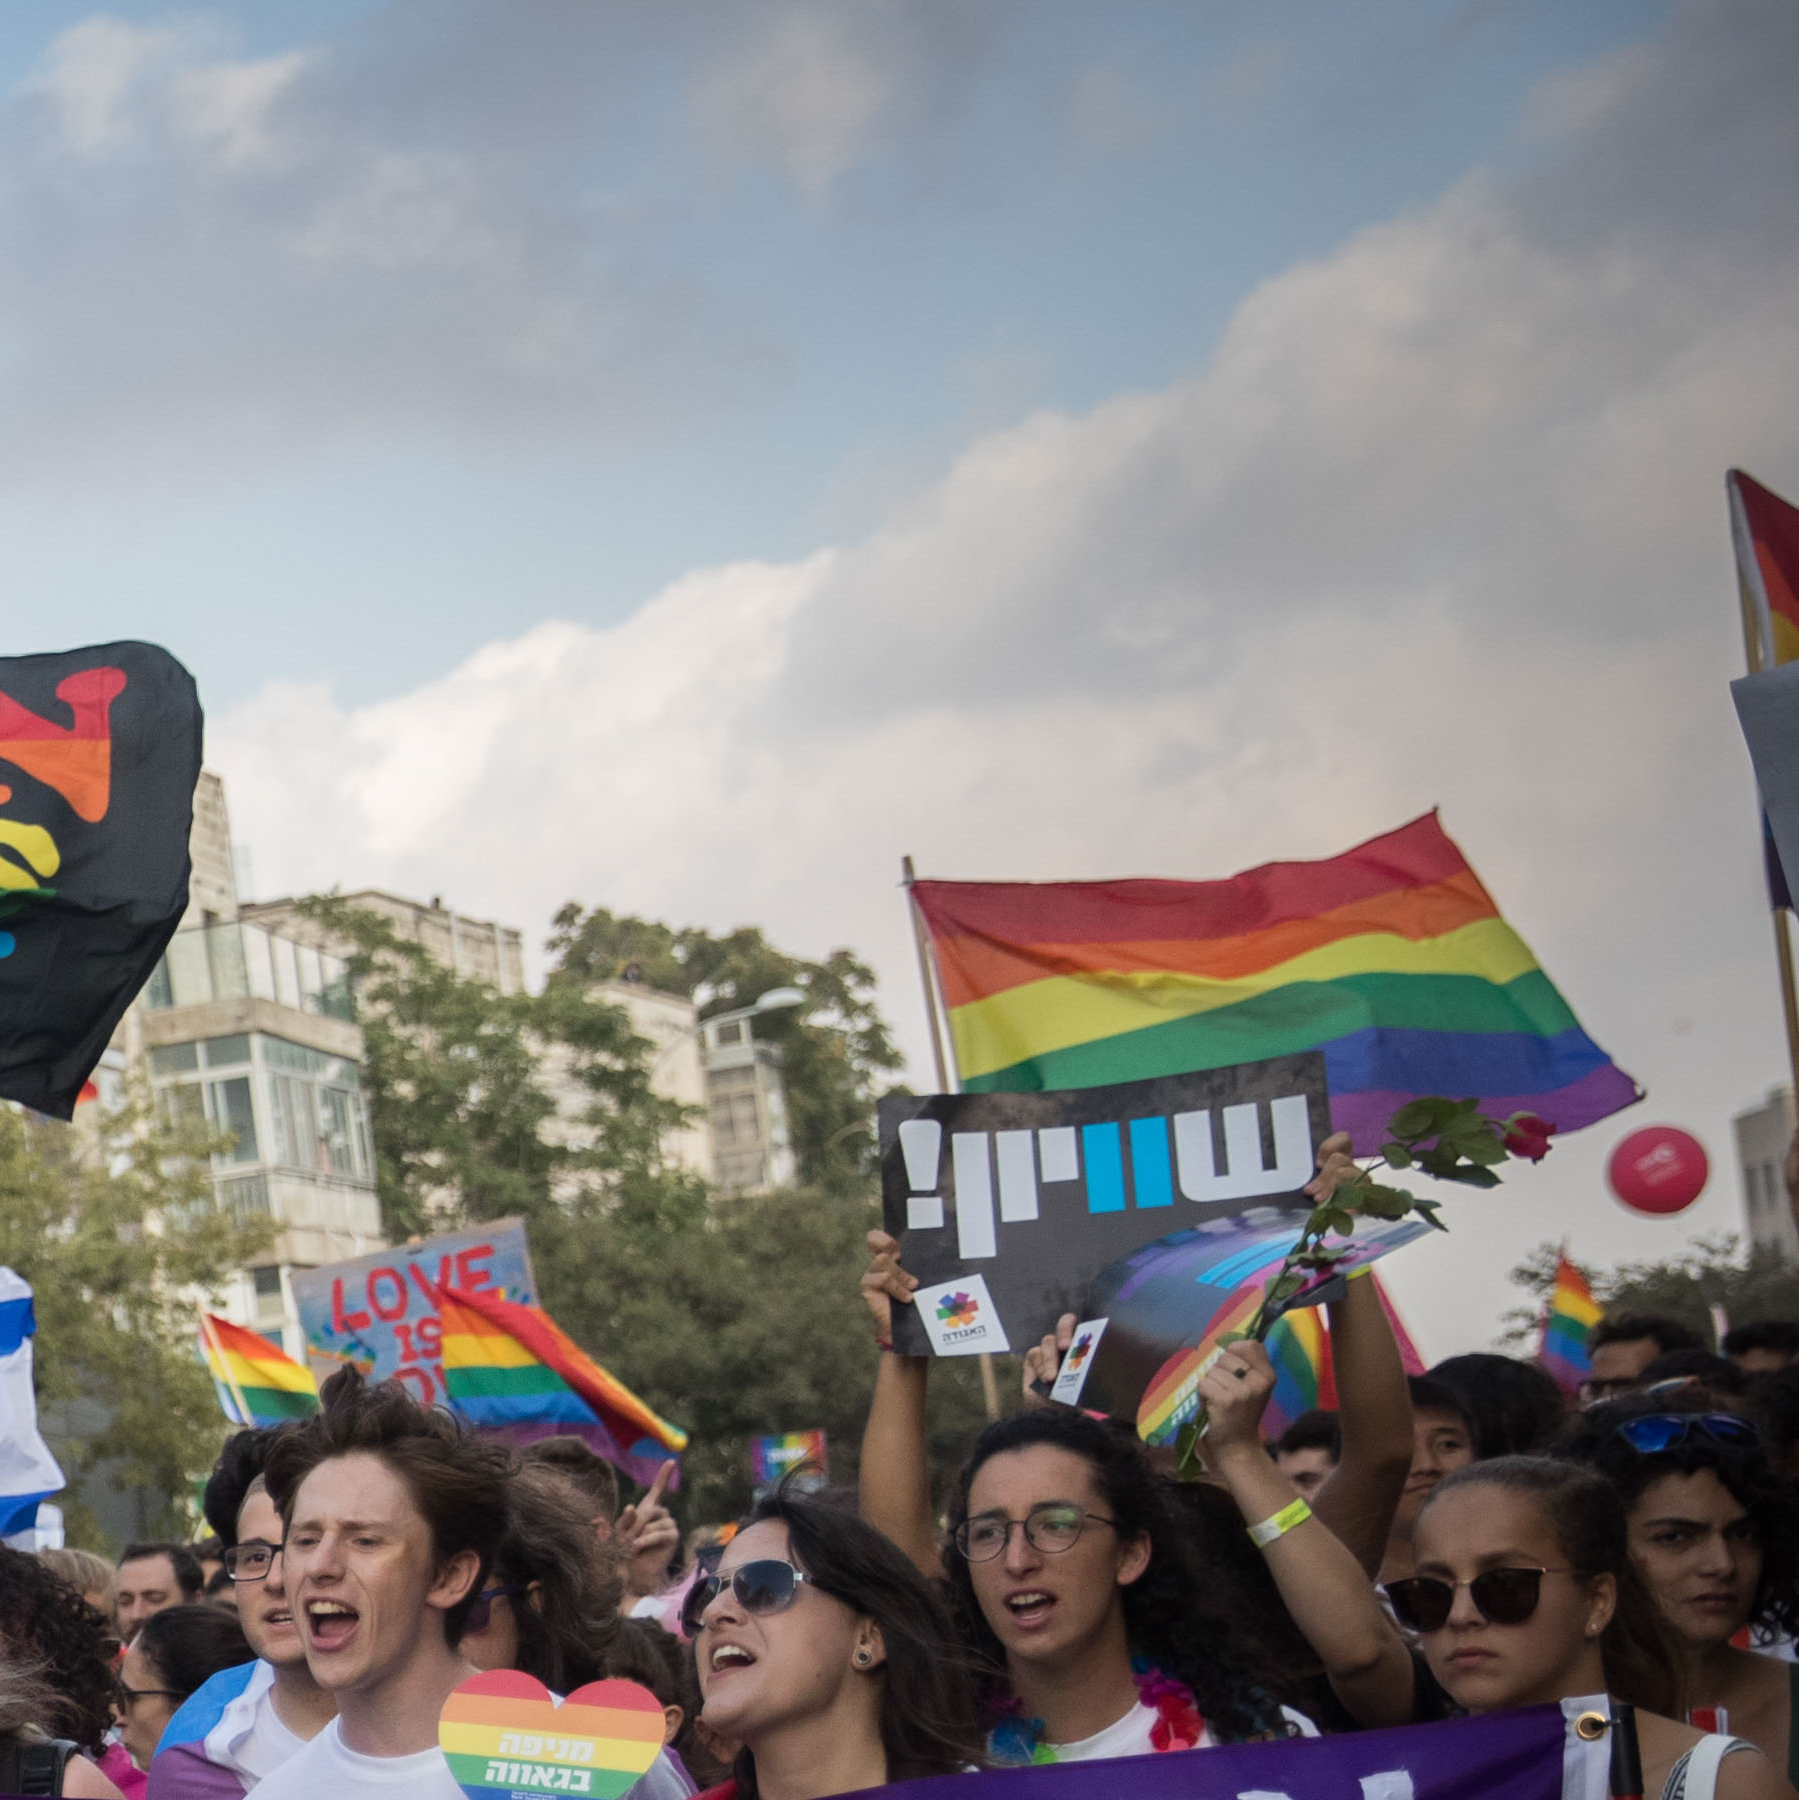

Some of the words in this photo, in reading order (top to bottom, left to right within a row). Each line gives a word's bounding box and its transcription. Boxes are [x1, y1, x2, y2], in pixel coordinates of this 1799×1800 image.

[899, 1094, 1314, 1260] שוויון!
[331, 1244, 502, 1335] LOVE
[484, 1760, 592, 1793] בגאווה
[498, 1732, 594, 1763] מניפה
